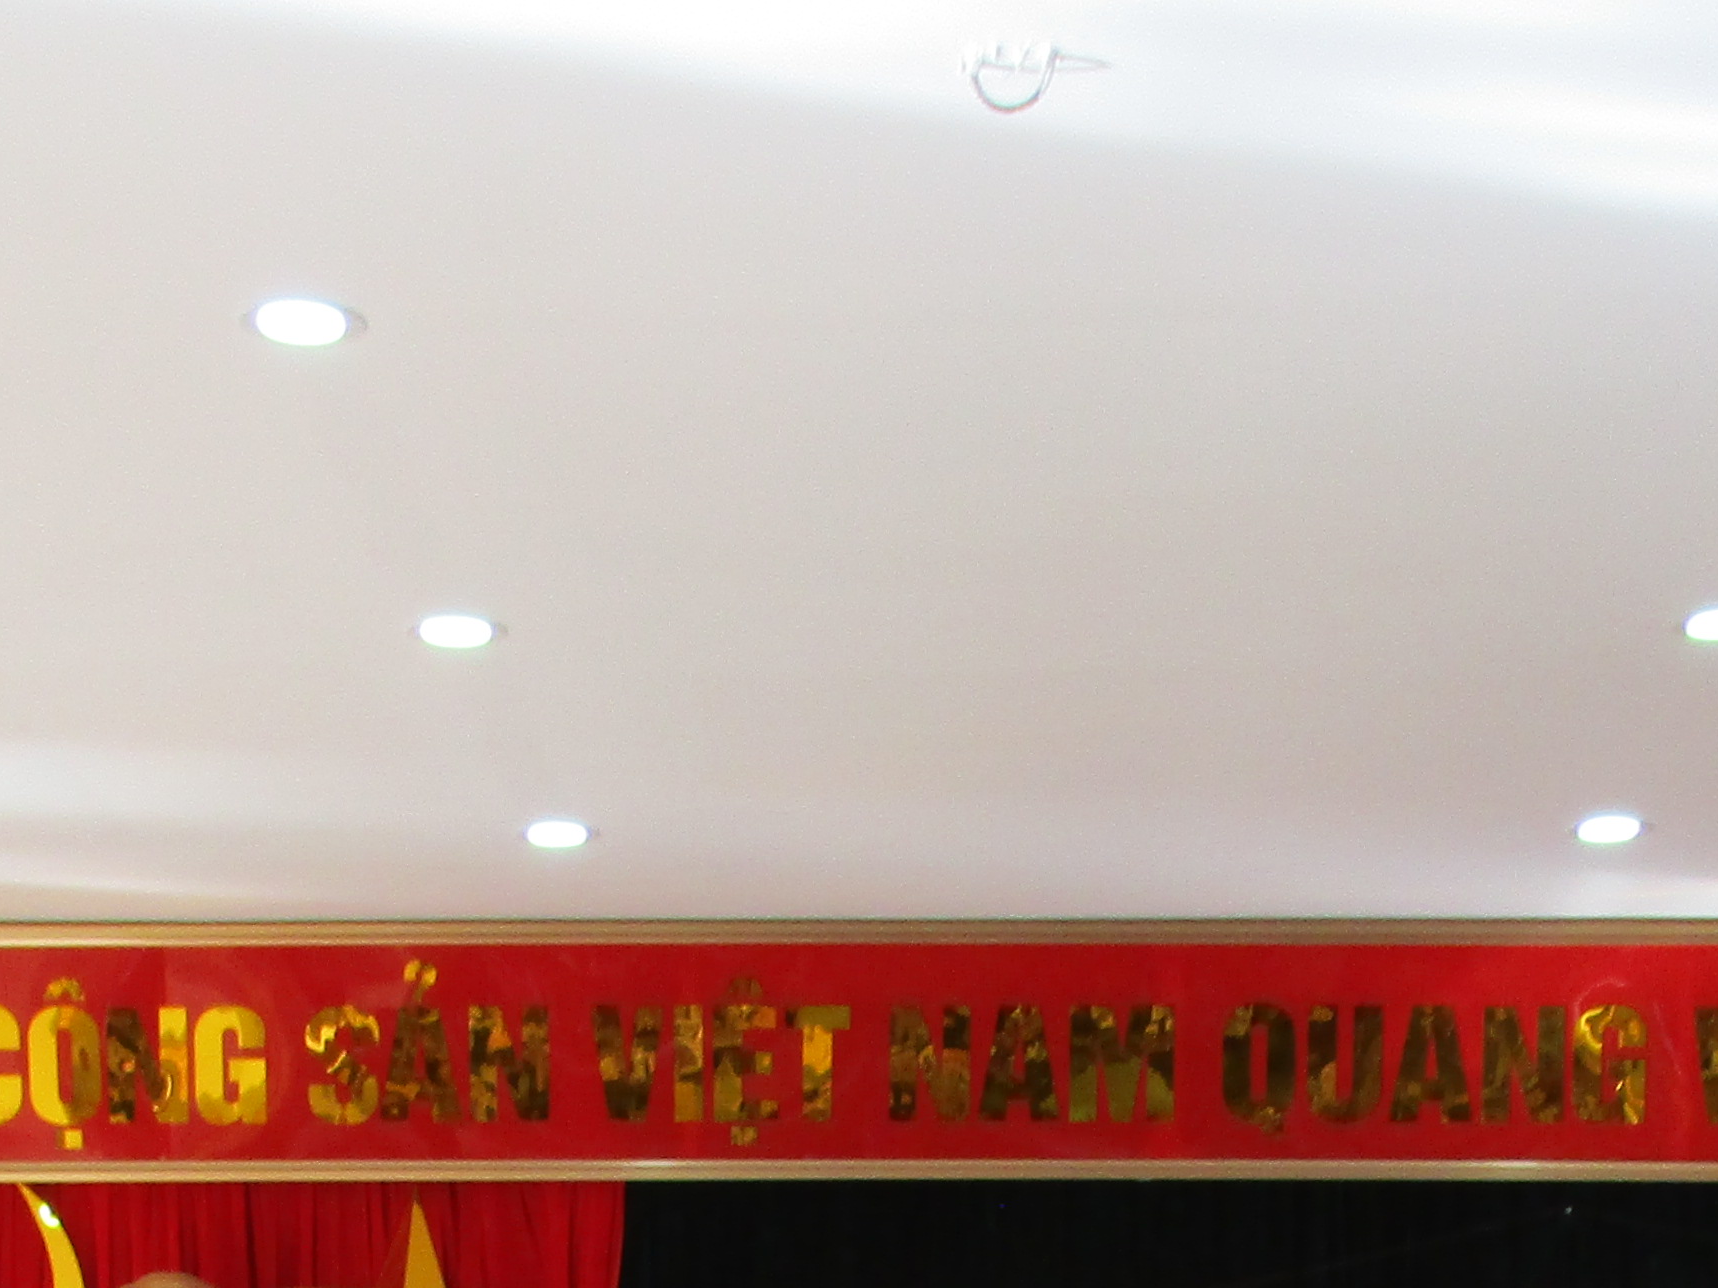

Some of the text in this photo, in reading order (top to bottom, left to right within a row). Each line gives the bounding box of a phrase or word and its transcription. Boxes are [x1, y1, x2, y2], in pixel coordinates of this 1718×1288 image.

[304, 956, 550, 1126] SẢN
[591, 972, 853, 1146] VIỆT
[886, 1002, 1177, 1124] NAM
[1220, 1002, 1649, 1136] QUANG
